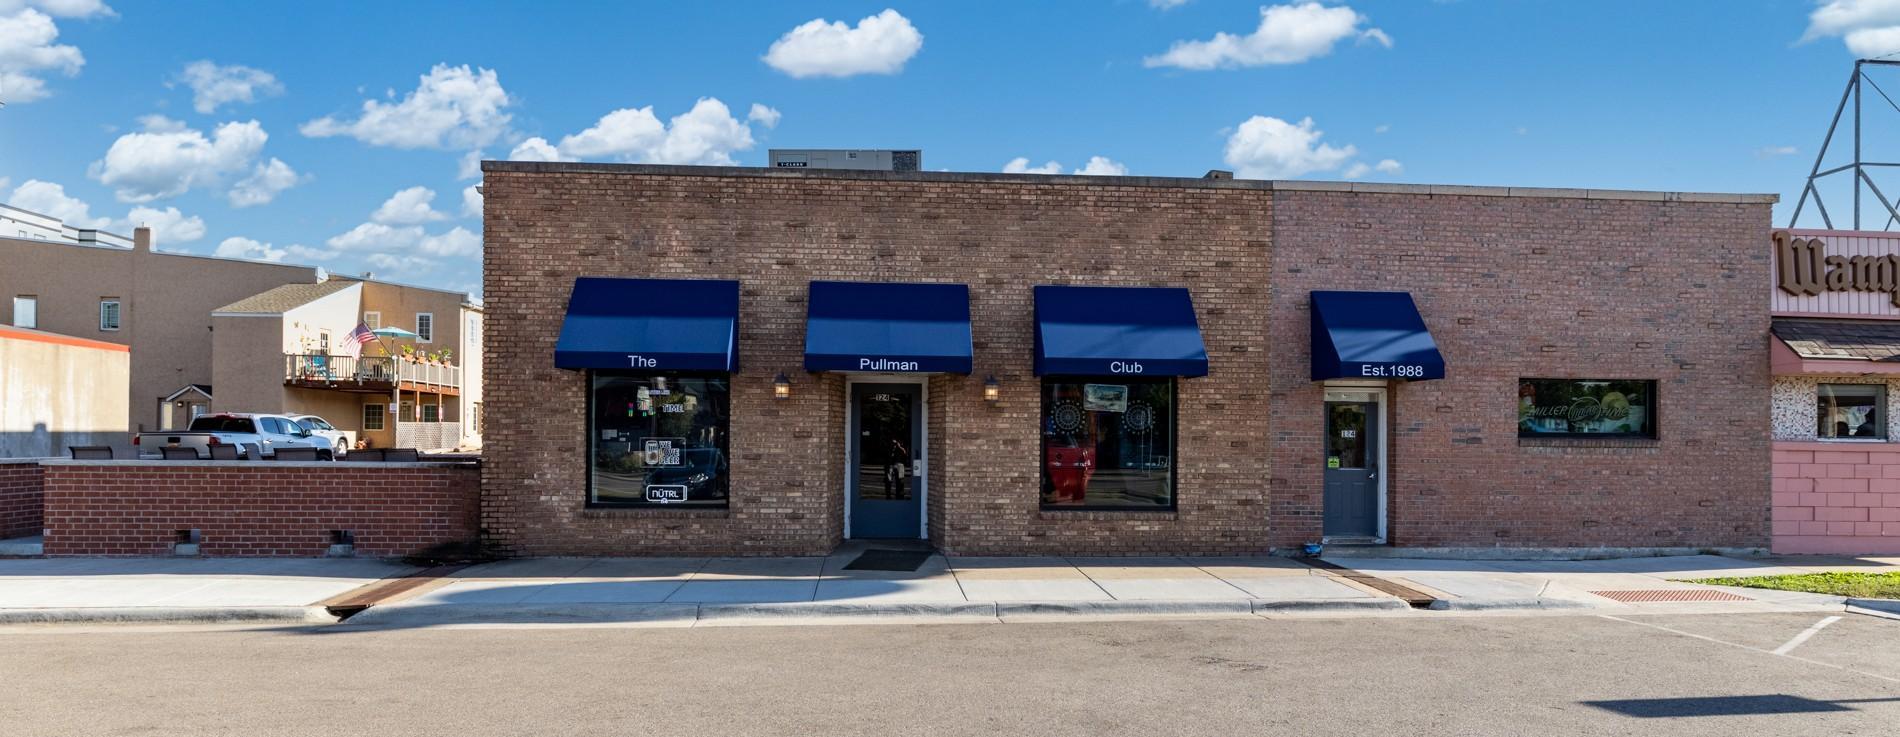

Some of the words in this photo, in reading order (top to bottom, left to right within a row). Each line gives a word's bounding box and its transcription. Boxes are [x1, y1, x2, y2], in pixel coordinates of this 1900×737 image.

[627, 354, 657, 368] The
[860, 358, 918, 371] Pullman
[1110, 361, 1143, 373] Club
